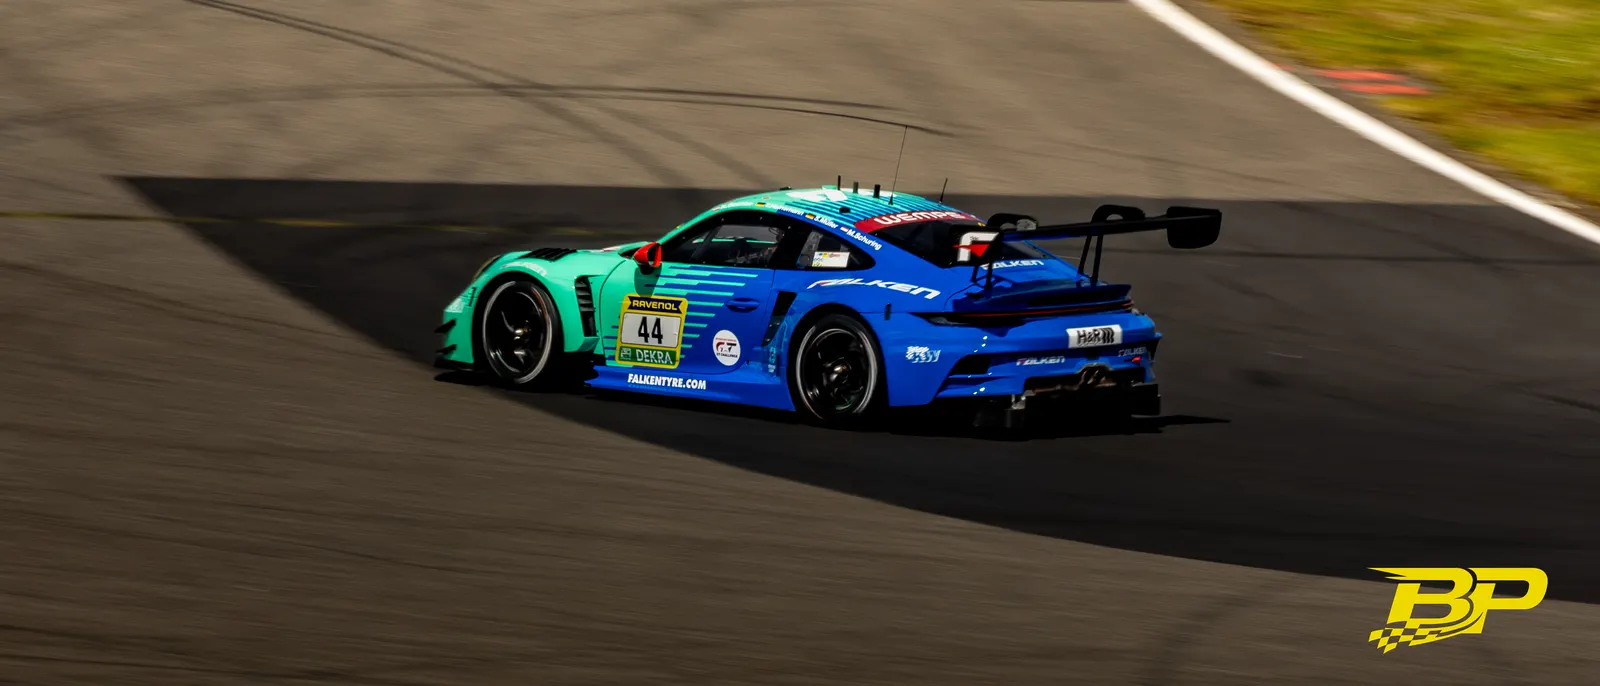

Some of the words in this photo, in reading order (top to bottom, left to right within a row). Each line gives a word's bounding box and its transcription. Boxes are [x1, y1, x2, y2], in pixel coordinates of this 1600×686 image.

[846, 229, 882, 250] M.Schuring
[806, 278, 941, 300] FALKEN
[632, 299, 678, 311] RAVENOL
[637, 316, 664, 344] 44
[636, 349, 673, 364] DEKRA
[627, 373, 707, 390] FALKENTYRE.COM
